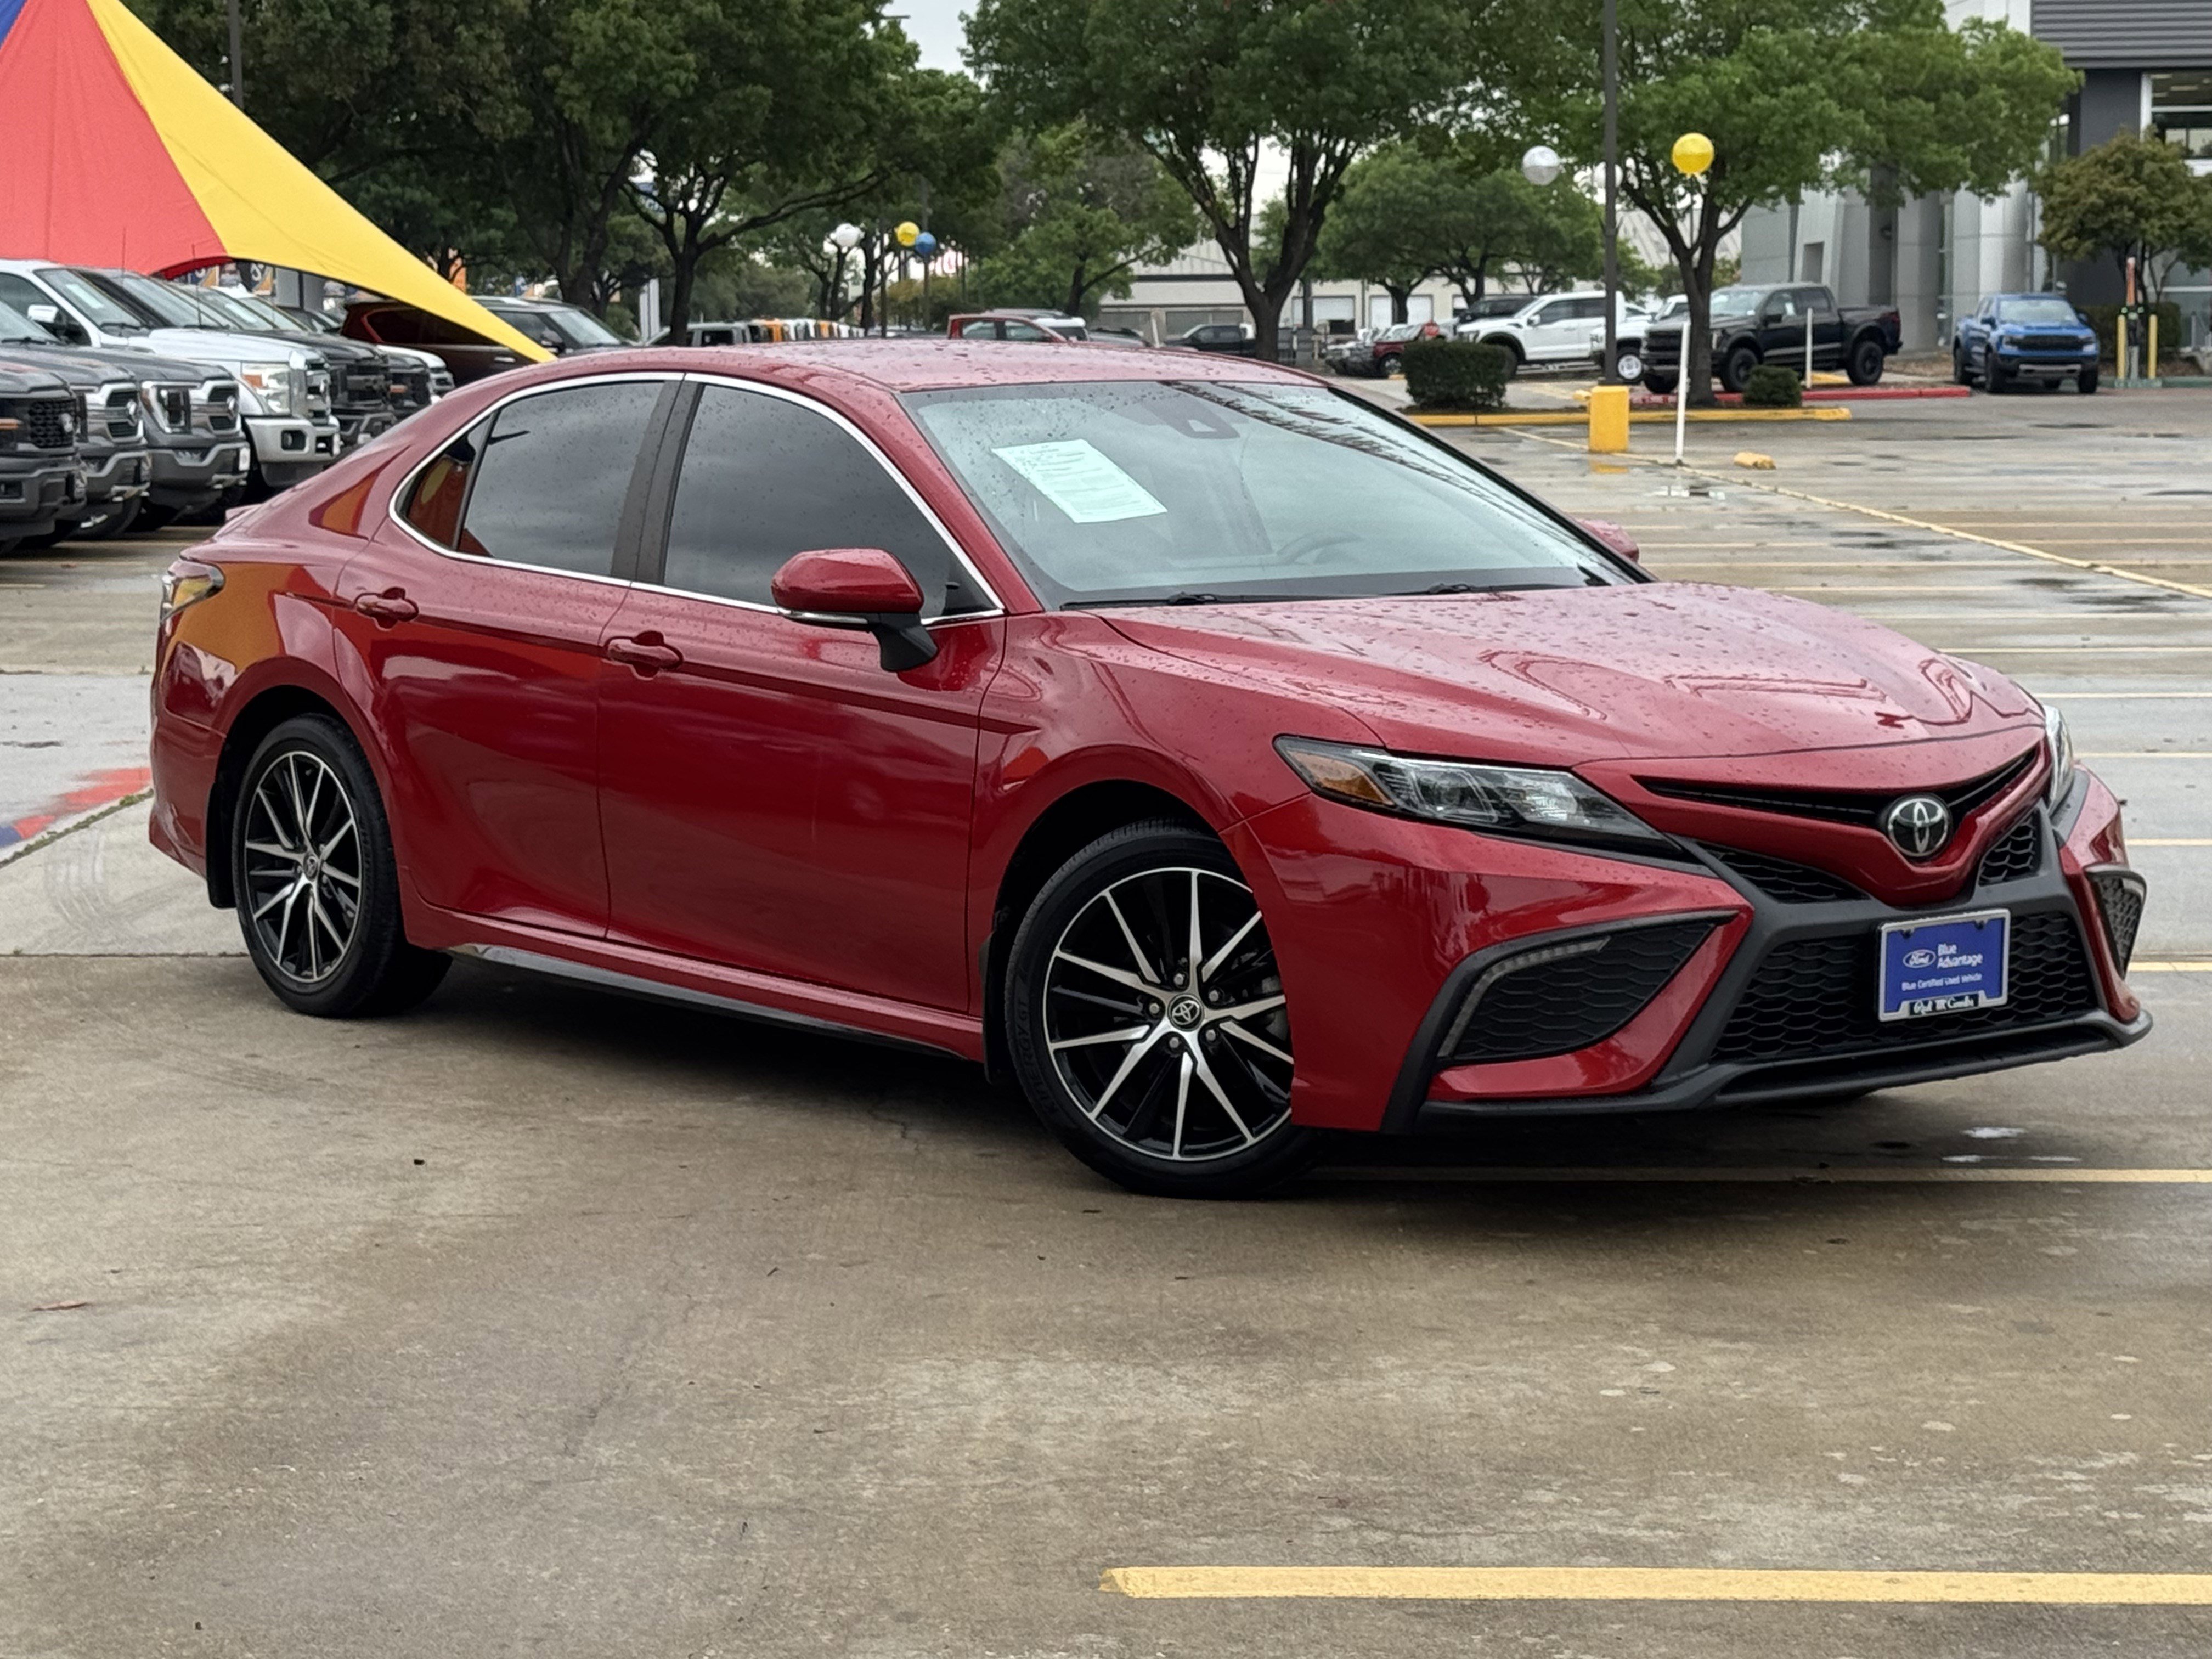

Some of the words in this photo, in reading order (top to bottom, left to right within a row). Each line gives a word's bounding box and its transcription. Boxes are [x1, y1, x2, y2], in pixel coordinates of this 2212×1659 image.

[1938, 943, 1957, 956] Blue
[1937, 953, 1983, 968] Advantage
[1902, 982, 1916, 991] Blue
[1917, 979, 1944, 989] Certified
[1945, 976, 1960, 985] Used
[1961, 973, 1982, 983] Vehicle
